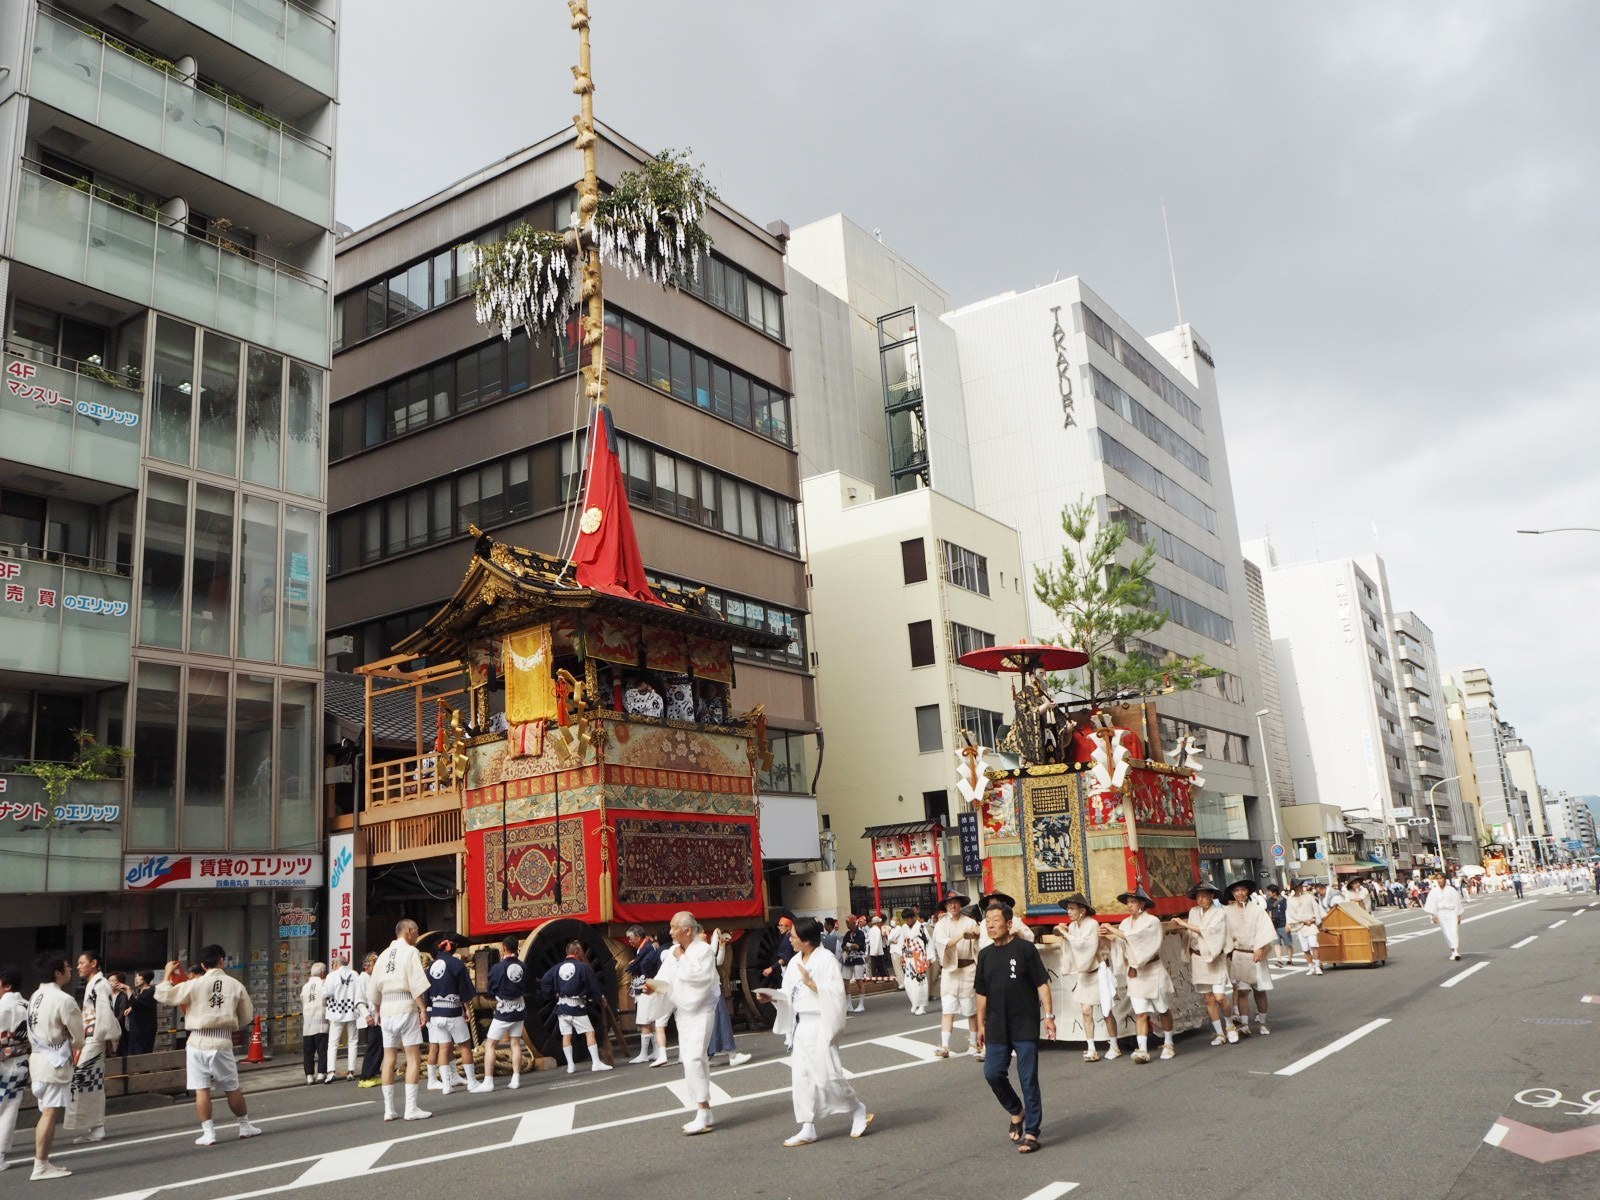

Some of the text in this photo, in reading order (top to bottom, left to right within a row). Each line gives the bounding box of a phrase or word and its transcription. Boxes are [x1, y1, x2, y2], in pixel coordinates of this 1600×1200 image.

[8, 362, 35, 378] 4F
[1049, 305, 1078, 430] TAKAKURA
[8, 380, 138, 425] マンスリー のエリッツ
[64, 596, 127, 616] のエリッツ
[200, 857, 312, 877] 賃貸のエリッツ
[898, 861, 930, 875] 松竹梅
